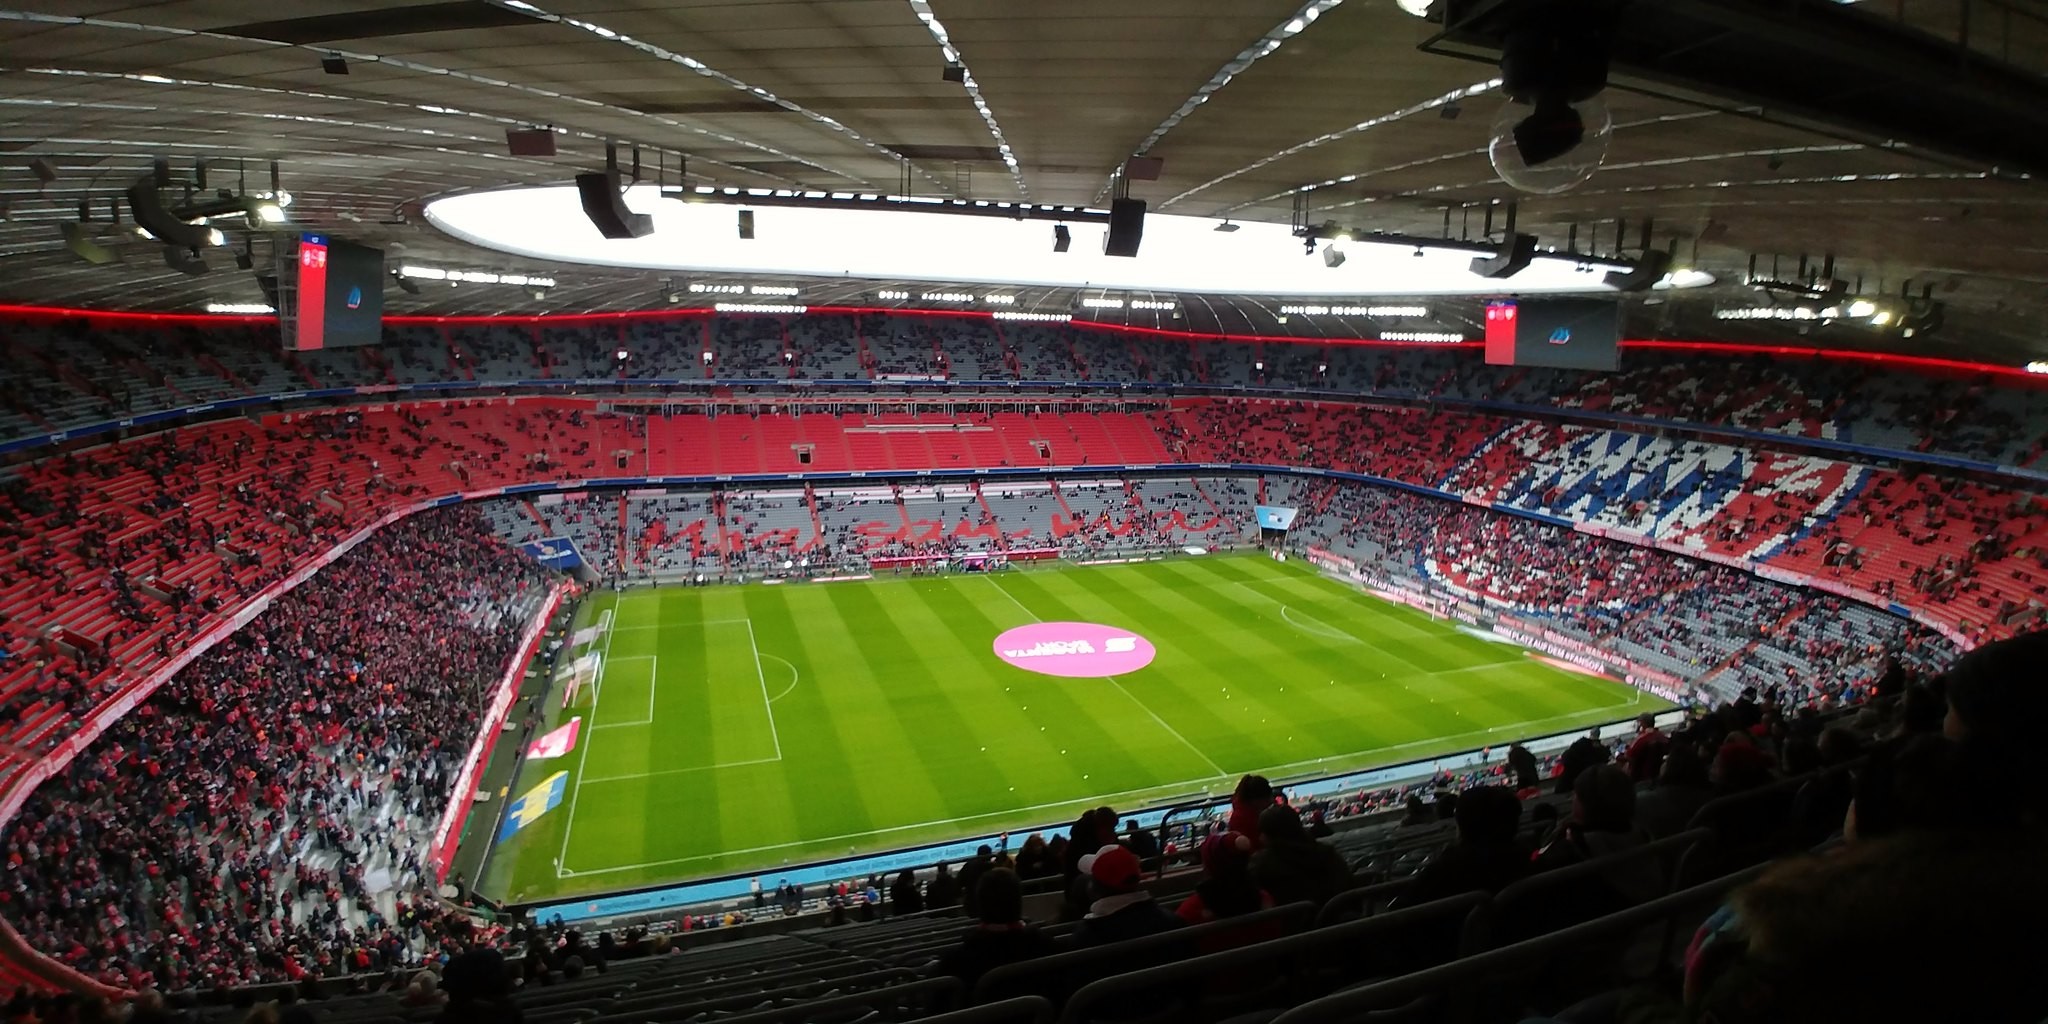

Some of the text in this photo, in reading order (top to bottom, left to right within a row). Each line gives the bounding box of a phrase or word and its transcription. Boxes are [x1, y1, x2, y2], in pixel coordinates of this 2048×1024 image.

[1493, 624, 1512, 641] NIMM
[1511, 630, 1533, 647] PLATZ
[1531, 638, 1548, 653] AUF
[1547, 643, 1565, 660] DEM
[1651, 685, 1680, 704] MOBIL
